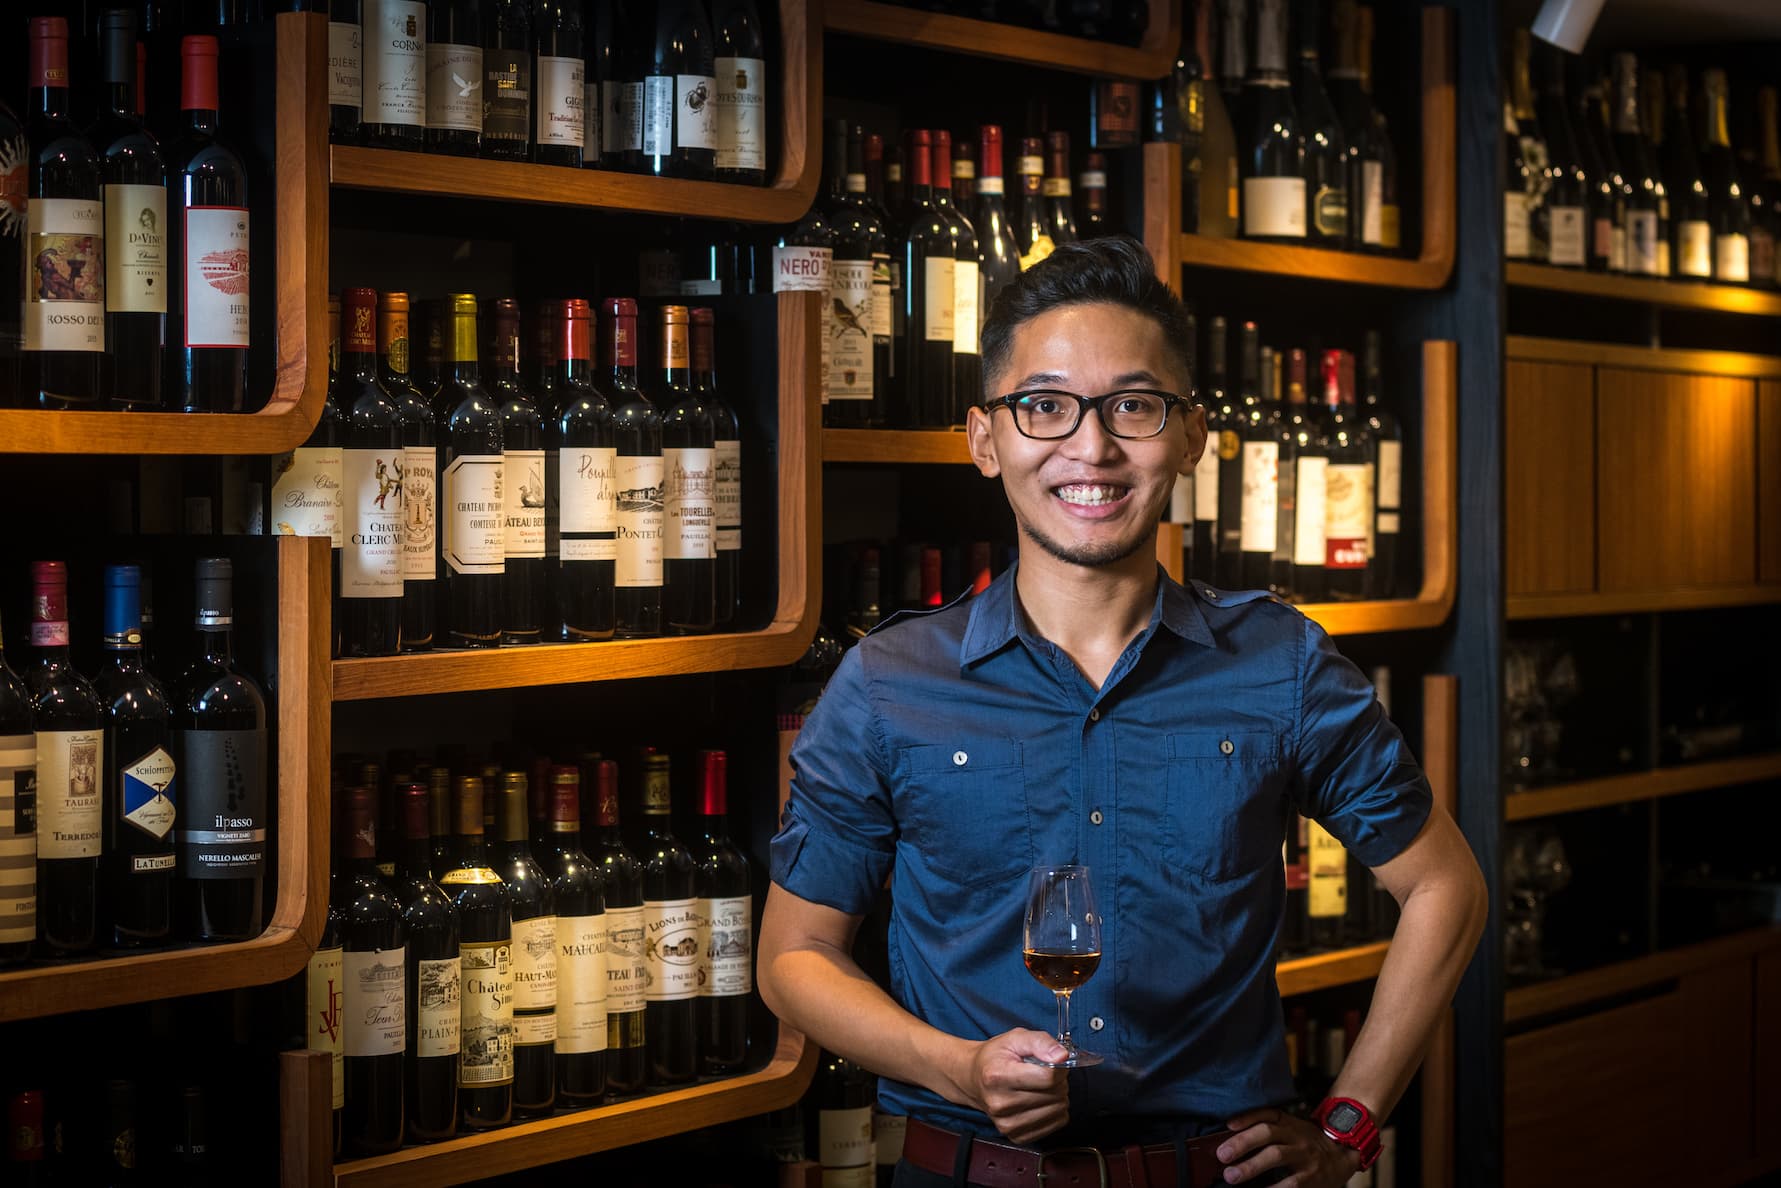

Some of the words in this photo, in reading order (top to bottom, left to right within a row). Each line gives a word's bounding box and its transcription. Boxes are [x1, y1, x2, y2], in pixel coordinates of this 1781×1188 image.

[780, 258, 820, 276] NERO
[47, 314, 85, 326] ROSSO
[457, 502, 485, 513] CHATEAU
[351, 533, 391, 545] CLERC
[215, 814, 253, 832] ilpasso
[198, 853, 231, 863] NERELLO
[649, 915, 678, 933] LIONS
